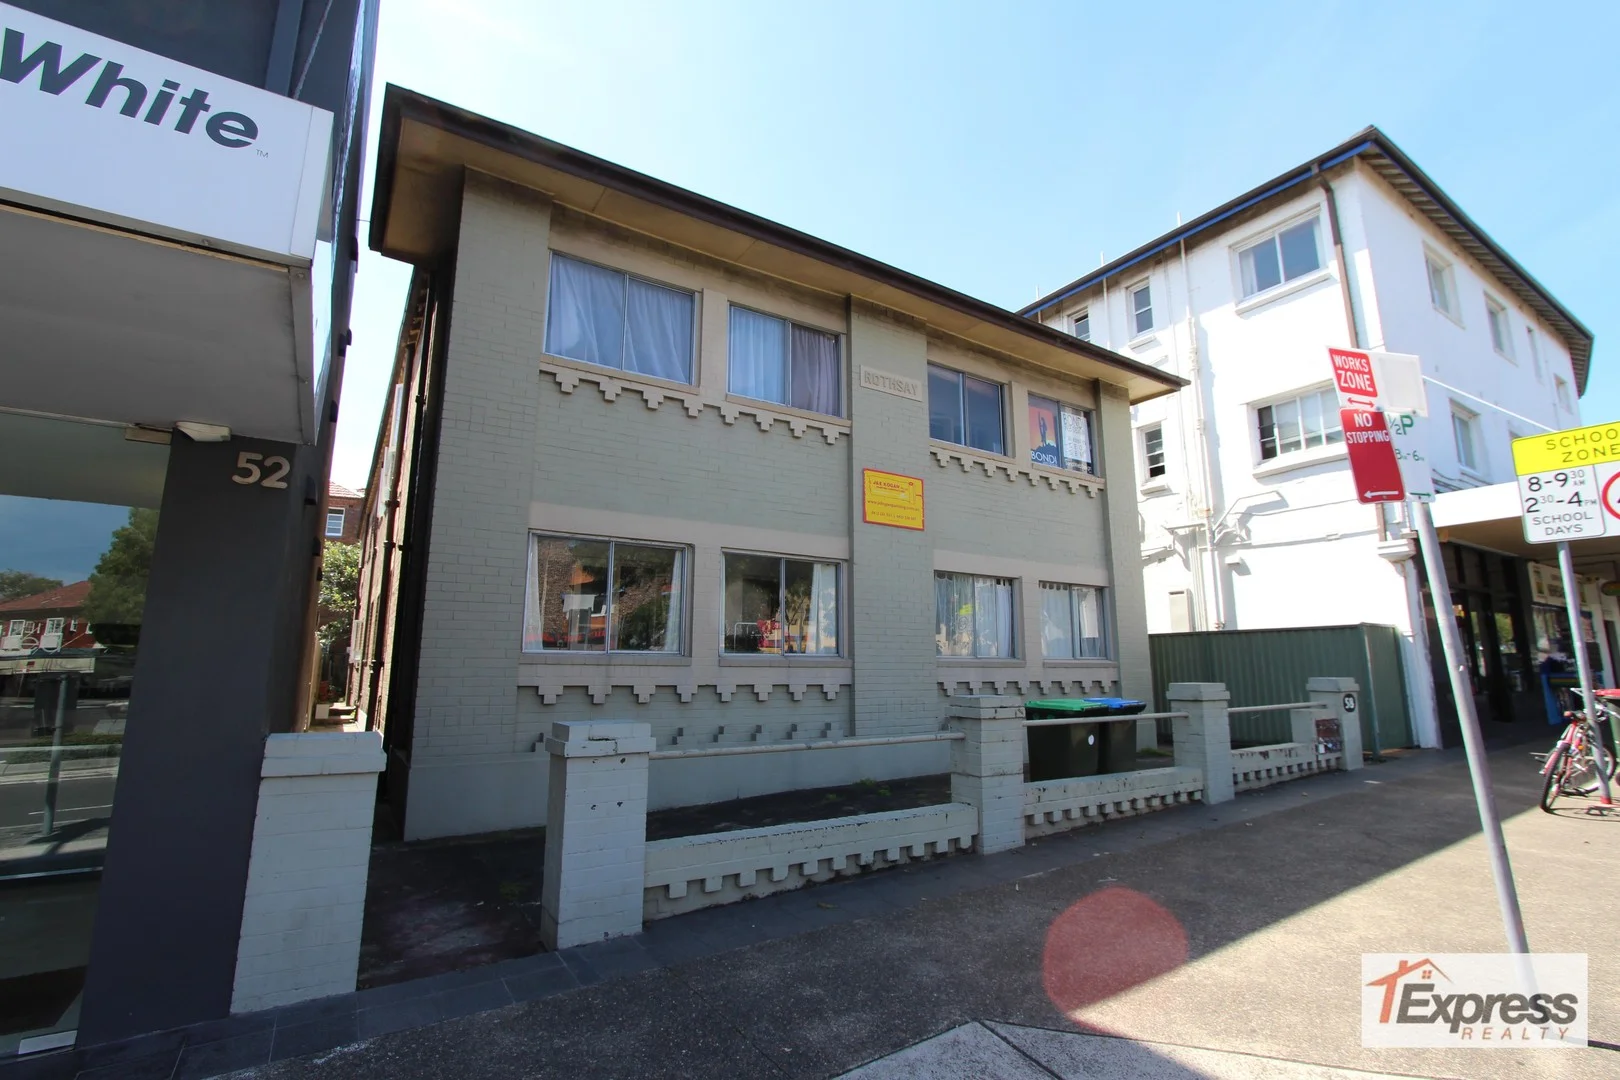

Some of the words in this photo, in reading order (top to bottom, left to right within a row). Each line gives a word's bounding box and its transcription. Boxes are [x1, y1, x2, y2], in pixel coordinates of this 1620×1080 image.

[0, 27, 259, 148] White
[1333, 354, 1369, 372] WORKS
[864, 370, 918, 395] ROTHSAY
[1337, 370, 1374, 392] ZONE
[1353, 413, 1373, 428] NO
[1346, 429, 1390, 444] STOPPING
[1545, 428, 1620, 450] SCHOO
[1031, 450, 1057, 464] BONDI
[1561, 443, 1620, 463] ZONE
[231, 451, 291, 489] 52
[1532, 511, 1594, 526] SCHOOL
[1544, 524, 1583, 536] DAYS
